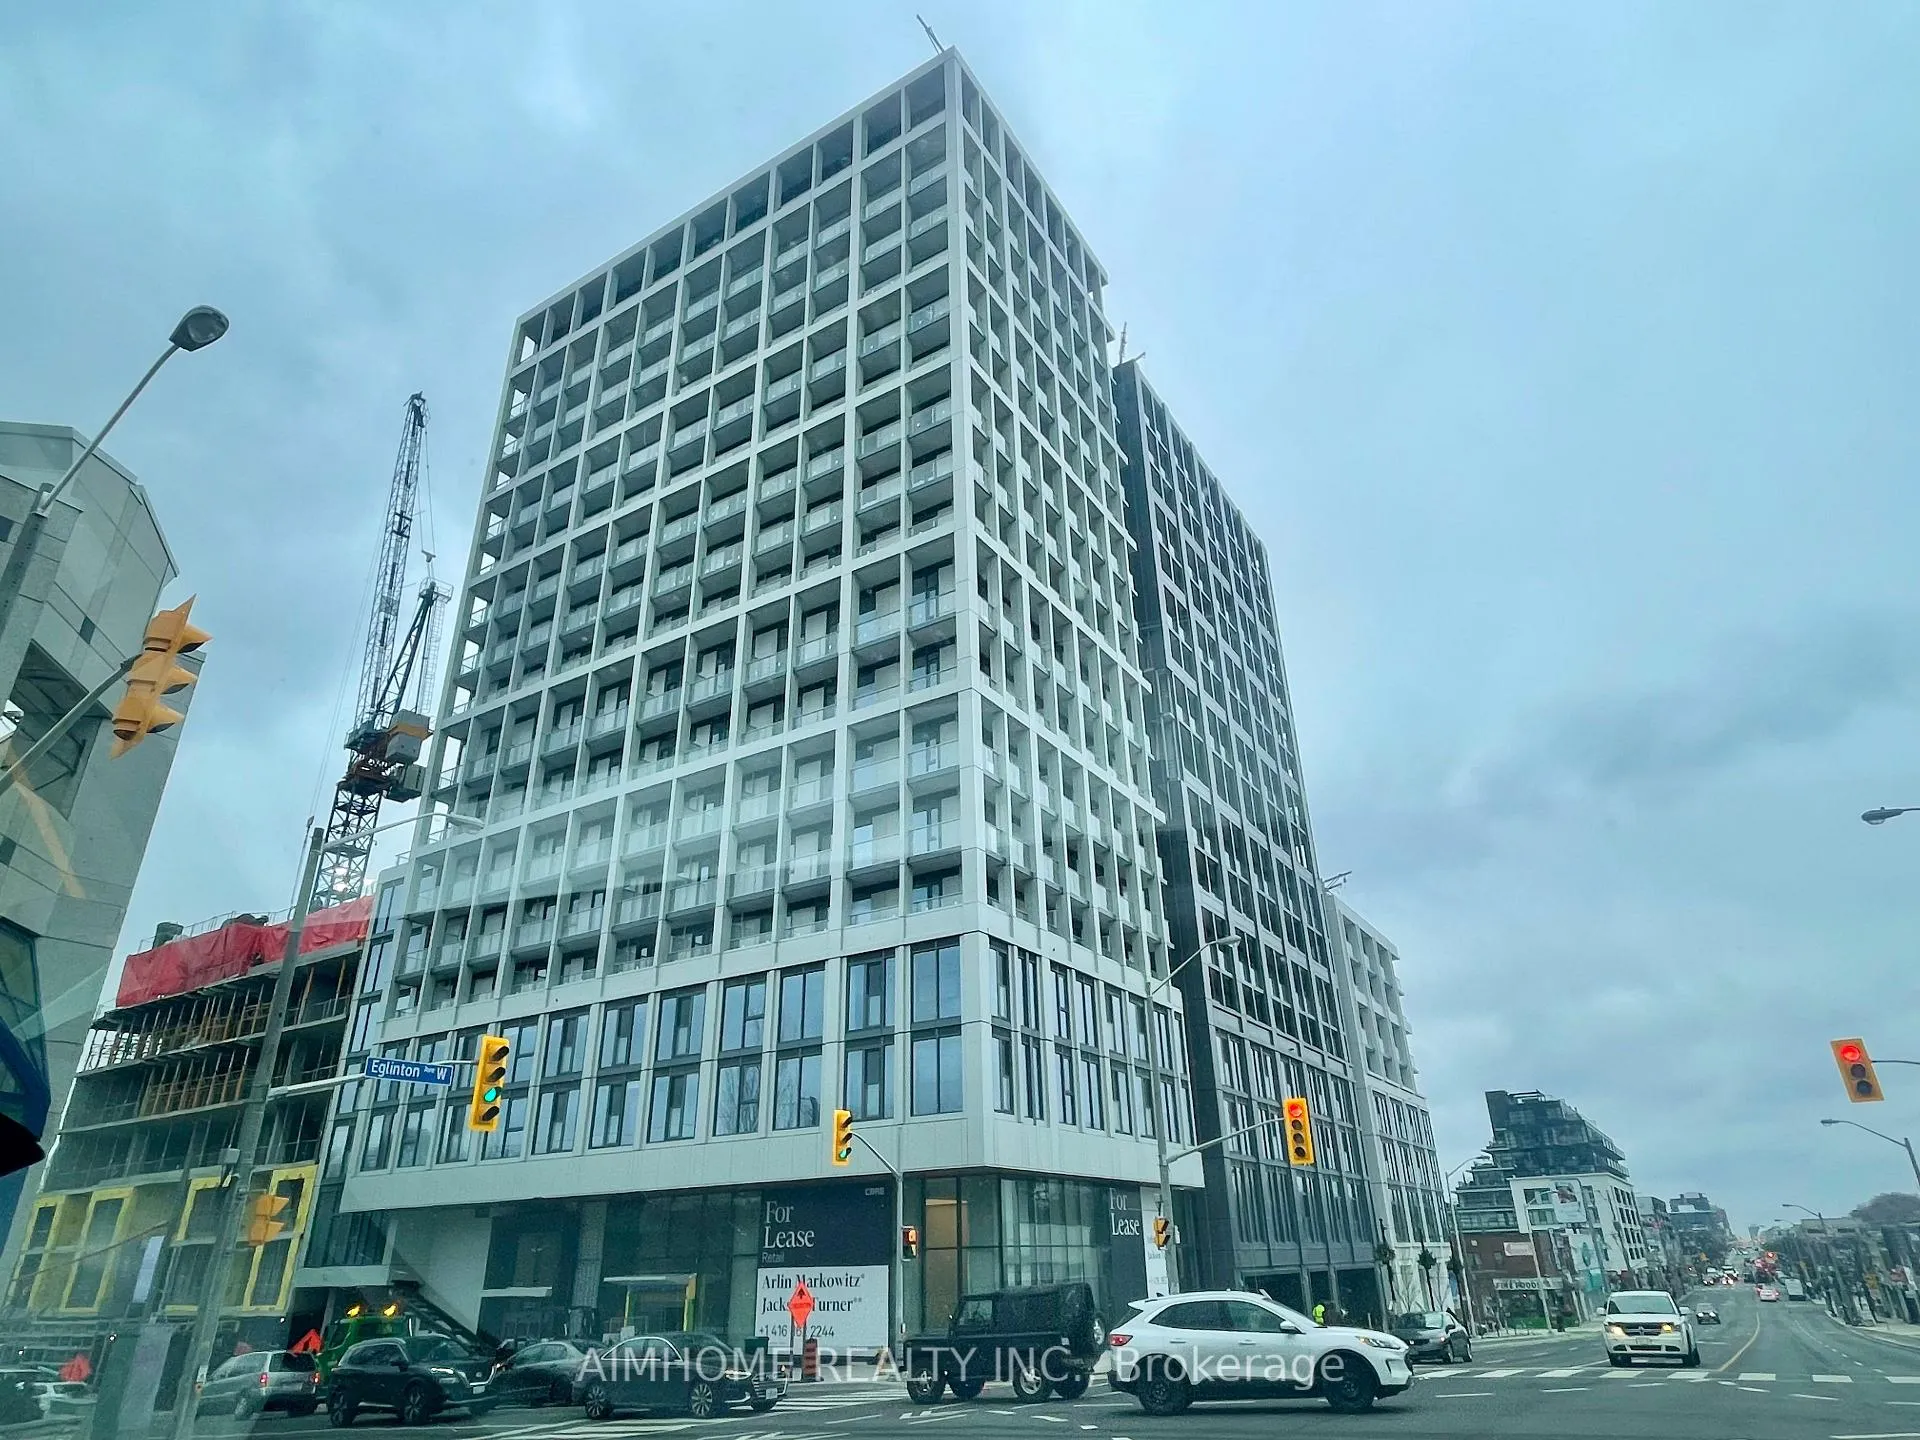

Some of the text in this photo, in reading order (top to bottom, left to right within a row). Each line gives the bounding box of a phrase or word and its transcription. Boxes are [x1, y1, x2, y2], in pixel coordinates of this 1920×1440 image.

[371, 1060, 420, 1077] Eglinton
[437, 1067, 447, 1080] W
[1109, 1188, 1128, 1210] For
[766, 1200, 794, 1223] For
[1111, 1213, 1140, 1235] Lease
[763, 1226, 815, 1249] Lease
[761, 1252, 785, 1263] Retail
[762, 1274, 792, 1289] Arlin
[771, 1324, 788, 1337] 416
[810, 1325, 835, 1338] 2244
